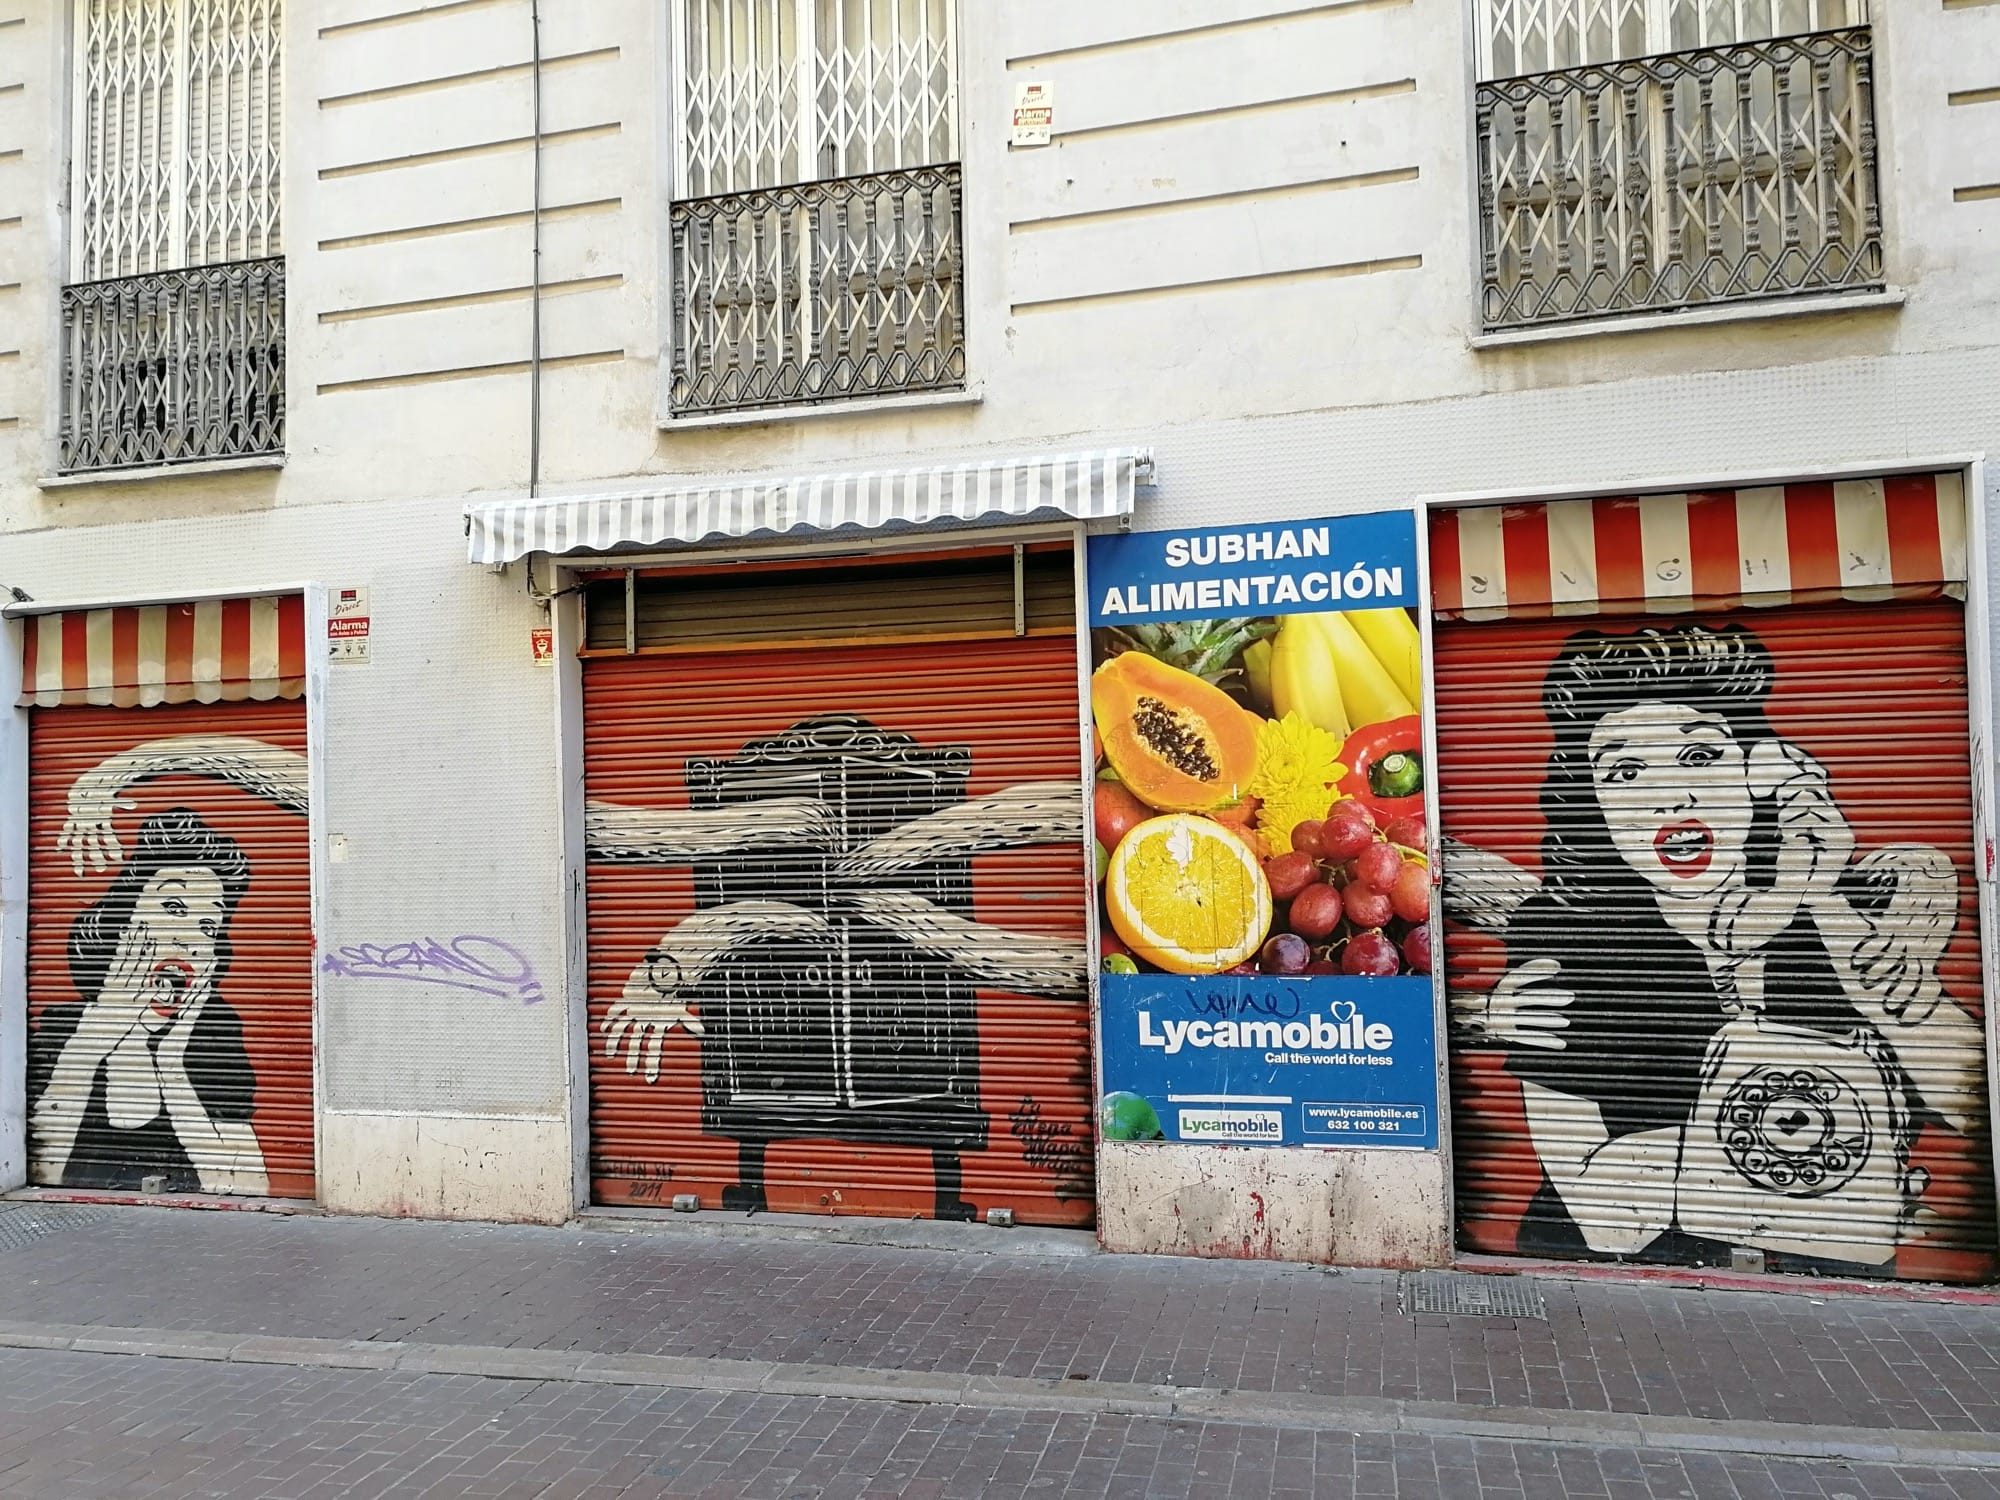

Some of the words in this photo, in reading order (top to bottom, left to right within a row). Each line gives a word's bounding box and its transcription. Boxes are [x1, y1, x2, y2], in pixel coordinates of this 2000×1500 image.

[1015, 108, 1050, 119] Alarma
[1165, 527, 1330, 568] SUBHAN
[1100, 561, 1403, 616] ALIMENTACIÓN
[330, 620, 367, 631] Alarma
[1138, 1001, 1394, 1054] Lycamobile
[1264, 1051, 1288, 1064] Call
[1290, 1053, 1311, 1064] the
[1312, 1053, 1347, 1065] world
[1348, 1053, 1367, 1065] for
[1367, 1054, 1394, 1066] less
[1308, 1107, 1419, 1119] www.lycamobile.es
[1182, 1116, 1278, 1133] Lycamobile
[1327, 1120, 1350, 1130] 632
[1353, 1120, 1375, 1131] 100
[1378, 1121, 1400, 1131] 321
